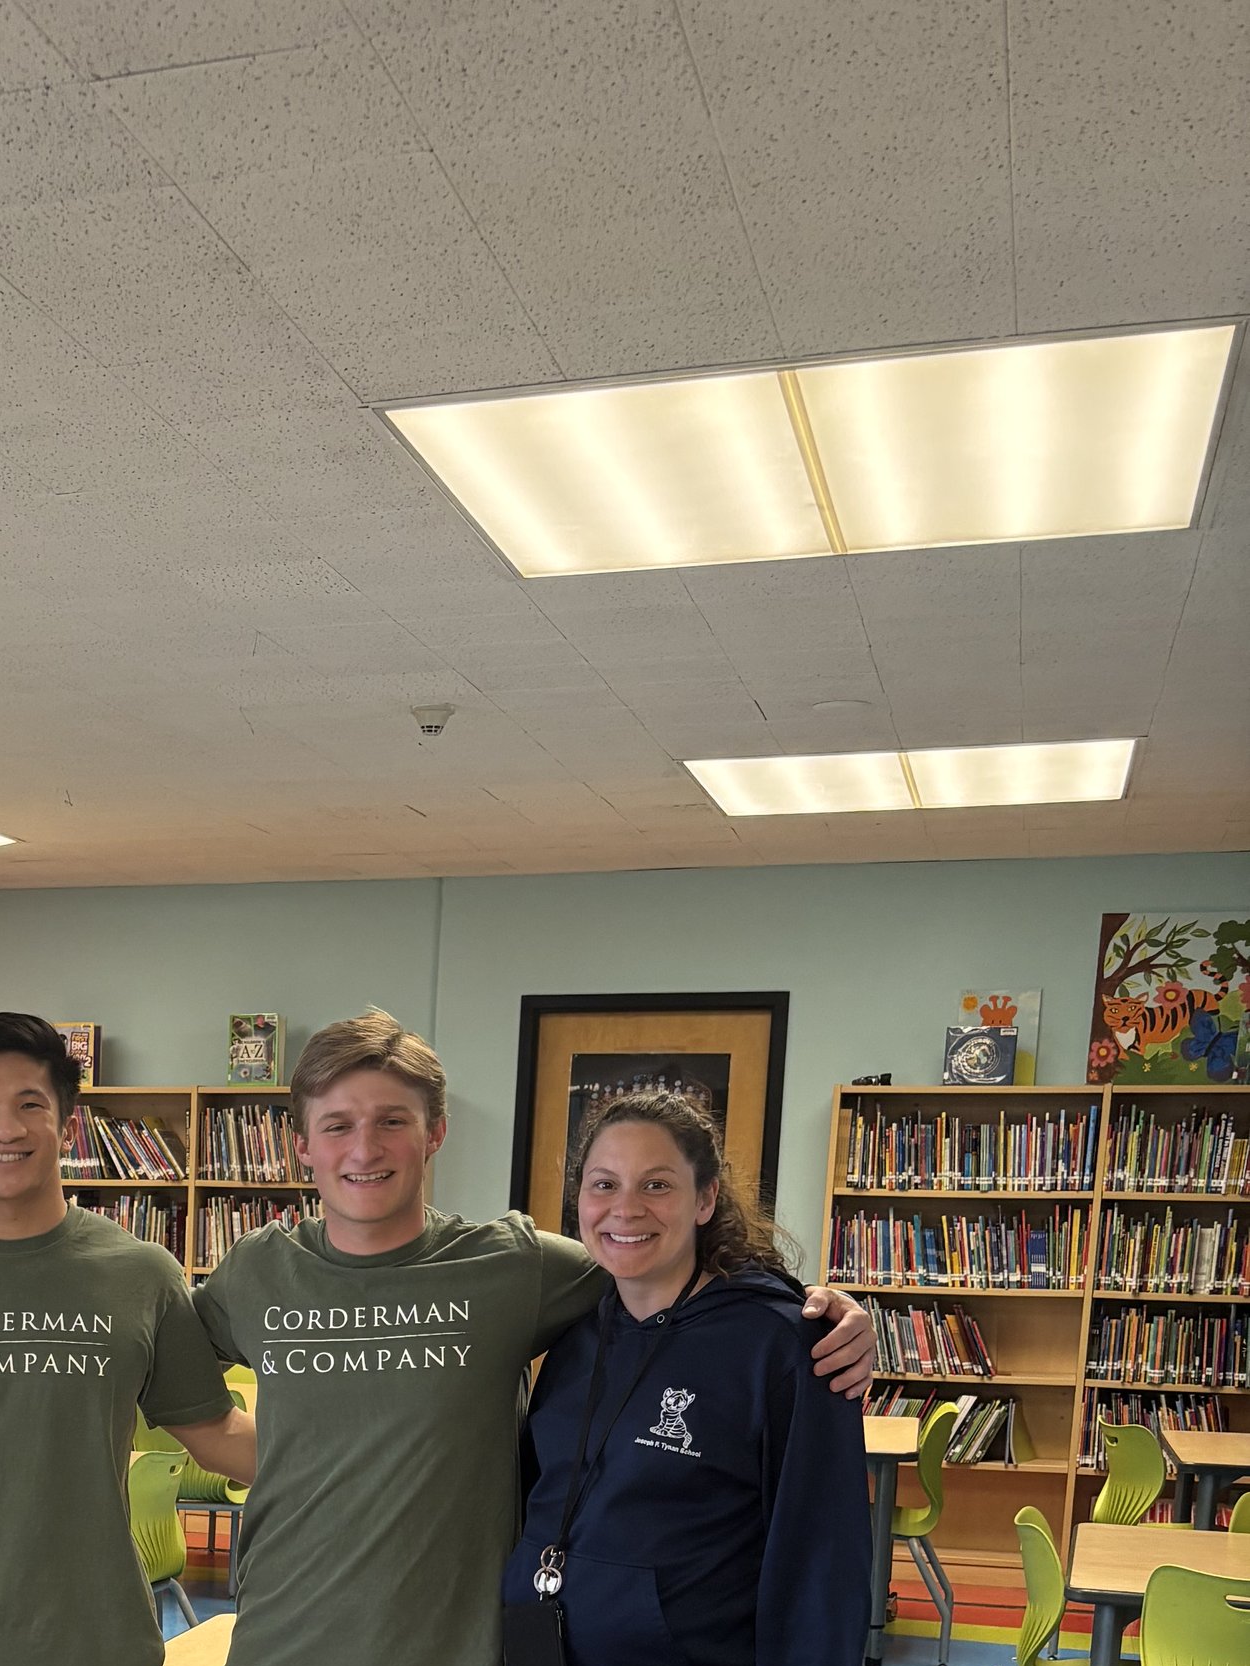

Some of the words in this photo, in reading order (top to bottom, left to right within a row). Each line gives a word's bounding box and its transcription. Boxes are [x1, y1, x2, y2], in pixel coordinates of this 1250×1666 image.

[71, 1041, 88, 1050] BIG
[240, 1044, 251, 1058] A
[254, 1044, 264, 1058] Z
[84, 1056, 92, 1066] 2
[264, 1300, 470, 1330] CORDERMAN
[261, 1350, 279, 1375] &
[286, 1344, 472, 1374] COMPANY
[634, 1436, 654, 1446] Joseph
[680, 1448, 702, 1458] School
